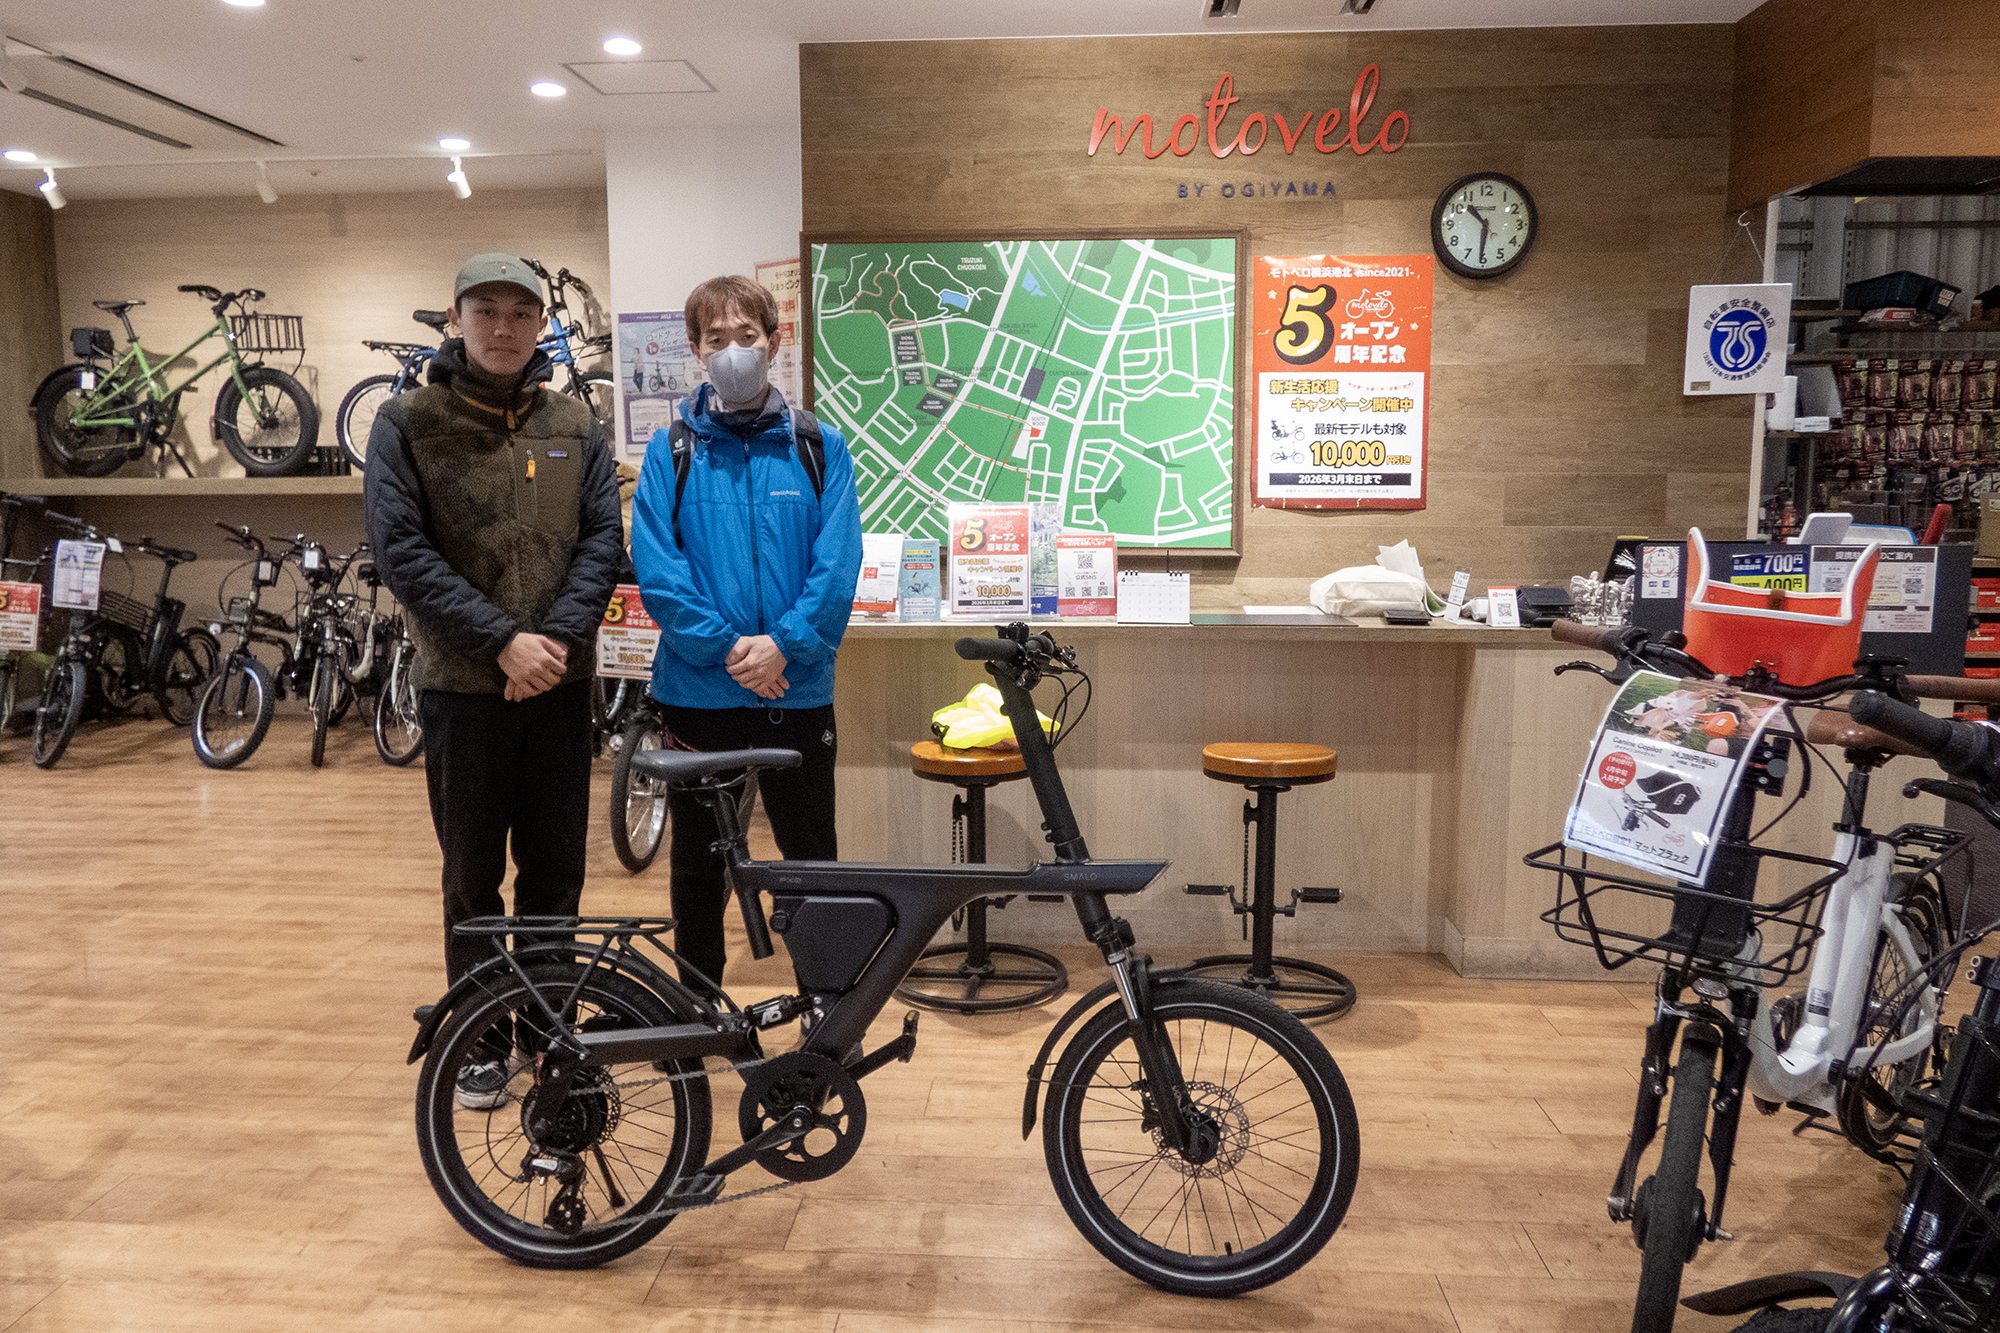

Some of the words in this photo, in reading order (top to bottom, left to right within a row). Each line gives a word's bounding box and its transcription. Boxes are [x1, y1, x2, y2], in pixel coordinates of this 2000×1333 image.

[1088, 64, 1410, 158] motovelo
[1177, 183, 1205, 198] BY
[1221, 181, 1337, 198] OGIYAMA
[1481, 185, 1494, 196] 12
[1464, 191, 1473, 202] 11
[1503, 191, 1507, 202] 1
[1451, 203, 1464, 214] 10
[1511, 203, 1519, 214] 2
[1446, 220, 1455, 230] 9
[1516, 220, 1523, 230] 3
[1450, 235, 1459, 246] 8
[1509, 236, 1517, 246] 4
[1464, 248, 1472, 259] 7
[1496, 248, 1504, 259] 5
[1270, 267, 1352, 278] モトベロ横浜港北
[1703, 298, 1776, 331] 自転車安全整備店
[1273, 284, 1337, 365] 5
[1340, 321, 1400, 341] オープン
[1334, 344, 1407, 364] 周年記念
[1269, 379, 1339, 395] 新生活応援
[1291, 397, 1414, 413] キャンペーン開催中
[1314, 423, 1407, 436] 最新モデルも対象
[1298, 474, 1382, 485] 2026年3月末日まで
[960, 518, 988, 553] 5
[989, 533, 1016, 541] オープン
[1764, 554, 1804, 573] 700円
[604, 596, 627, 624] 5
